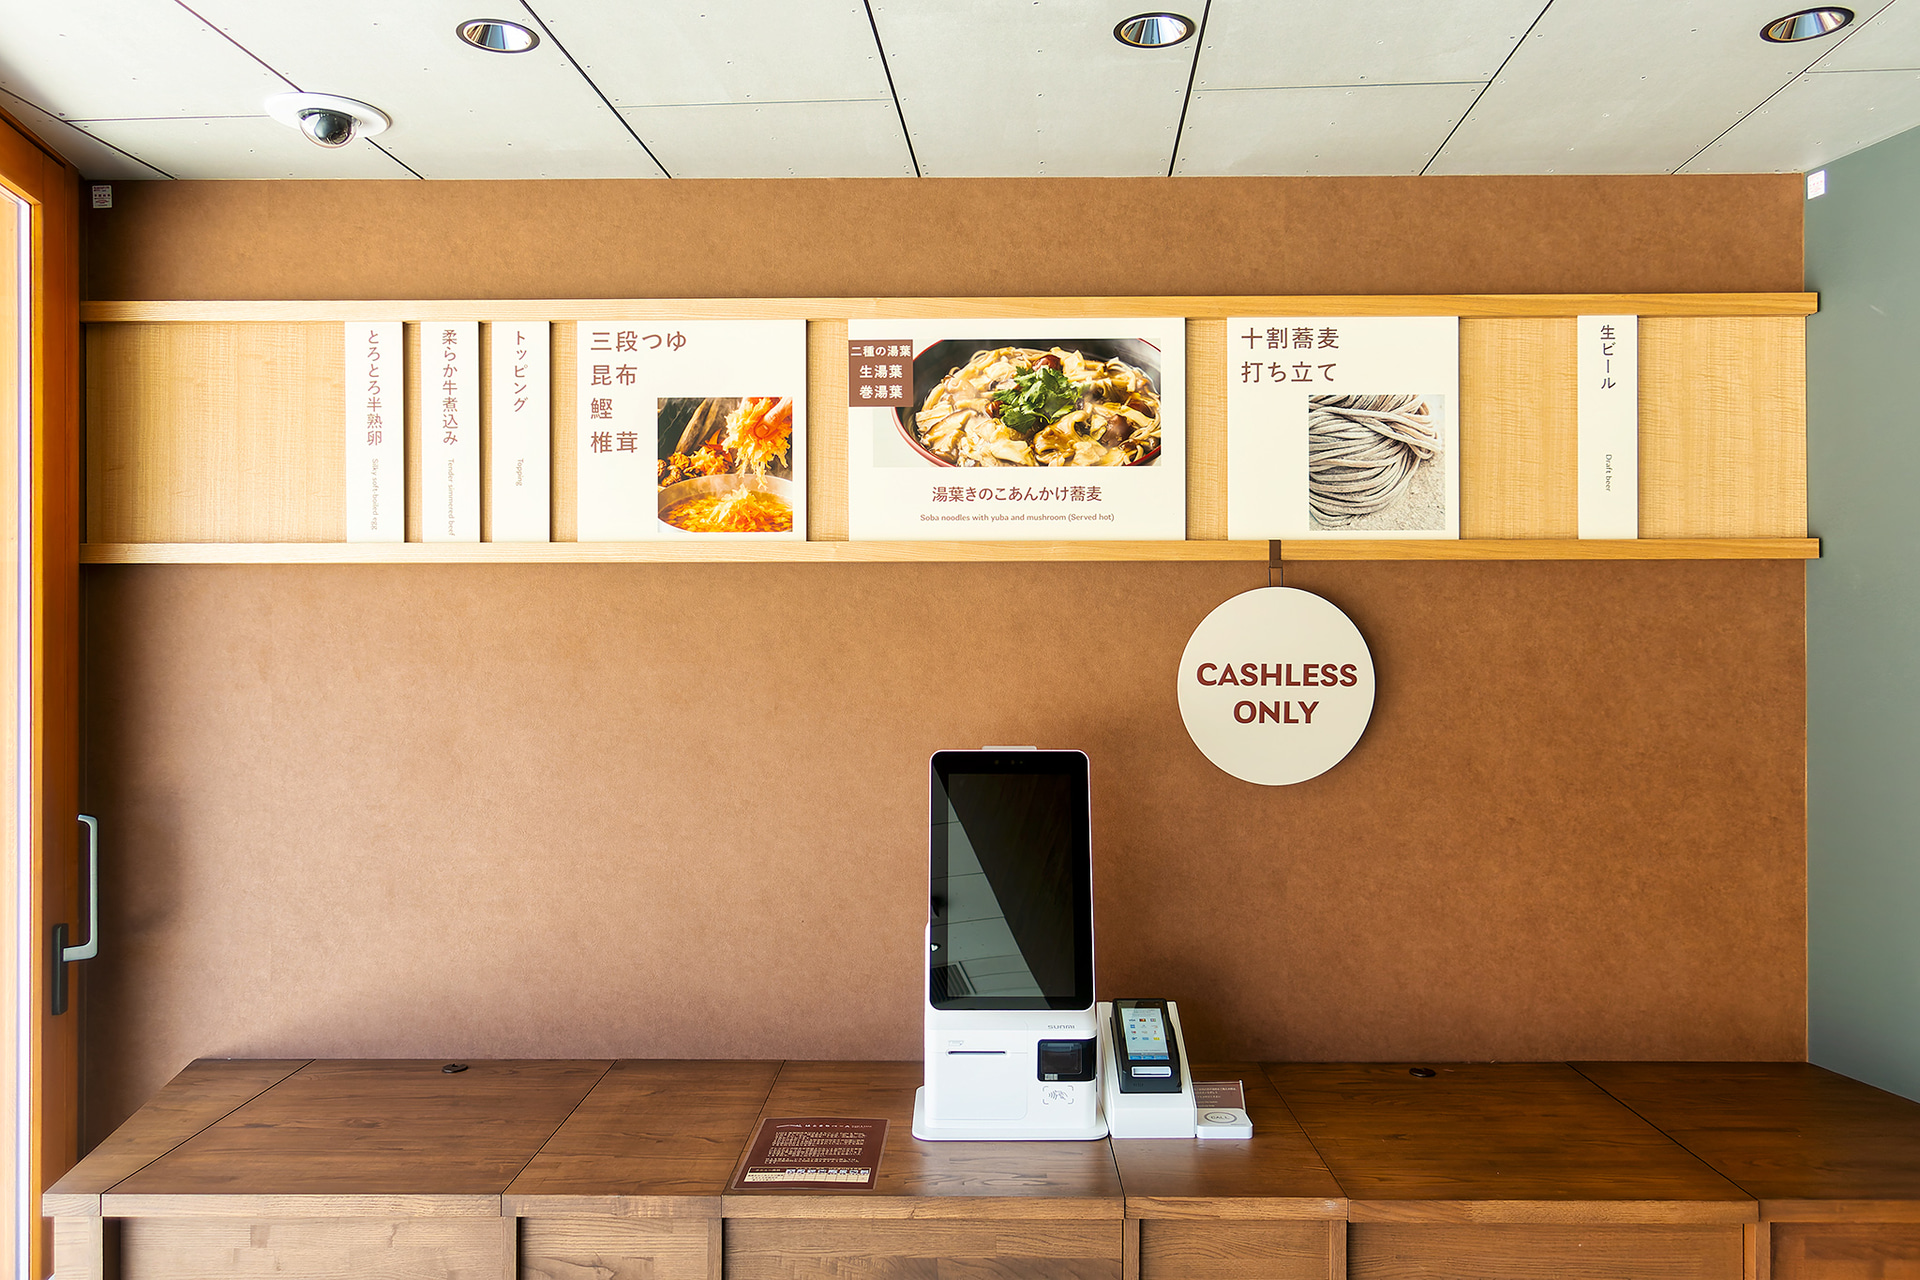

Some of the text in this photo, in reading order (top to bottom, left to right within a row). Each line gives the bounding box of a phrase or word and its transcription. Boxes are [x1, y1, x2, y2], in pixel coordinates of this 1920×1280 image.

[590, 330, 687, 352] 三段つゆ
[1241, 327, 1339, 349] 十割蕎麦
[850, 345, 912, 357] 二種の湯葉
[1600, 324, 1616, 390] 生ビール
[513, 330, 528, 412] トッピング
[590, 363, 638, 386] 昆布
[859, 364, 903, 379] 生湯葉
[1241, 361, 1337, 383] 打ち立て
[366, 329, 383, 446] とろとろ半熟卵
[442, 329, 458, 445] 柔らか牛煮込み
[859, 385, 903, 399] 巻湯葉
[590, 397, 613, 419] 鰹
[590, 431, 638, 454] 椎茸
[371, 458, 379, 475] Silky
[516, 458, 524, 487] Topping
[932, 485, 1103, 503] 湯葉きのこあんかけ蕎麦
[448, 520, 456, 536] beef
[991, 514, 1009, 522] yuba
[1026, 513, 1066, 521] mushroom
[1068, 513, 1097, 522] (Served
[1098, 513, 1115, 522] hot)
[1197, 663, 1358, 687] CASHLESS
[1233, 700, 1320, 724] ONLY
